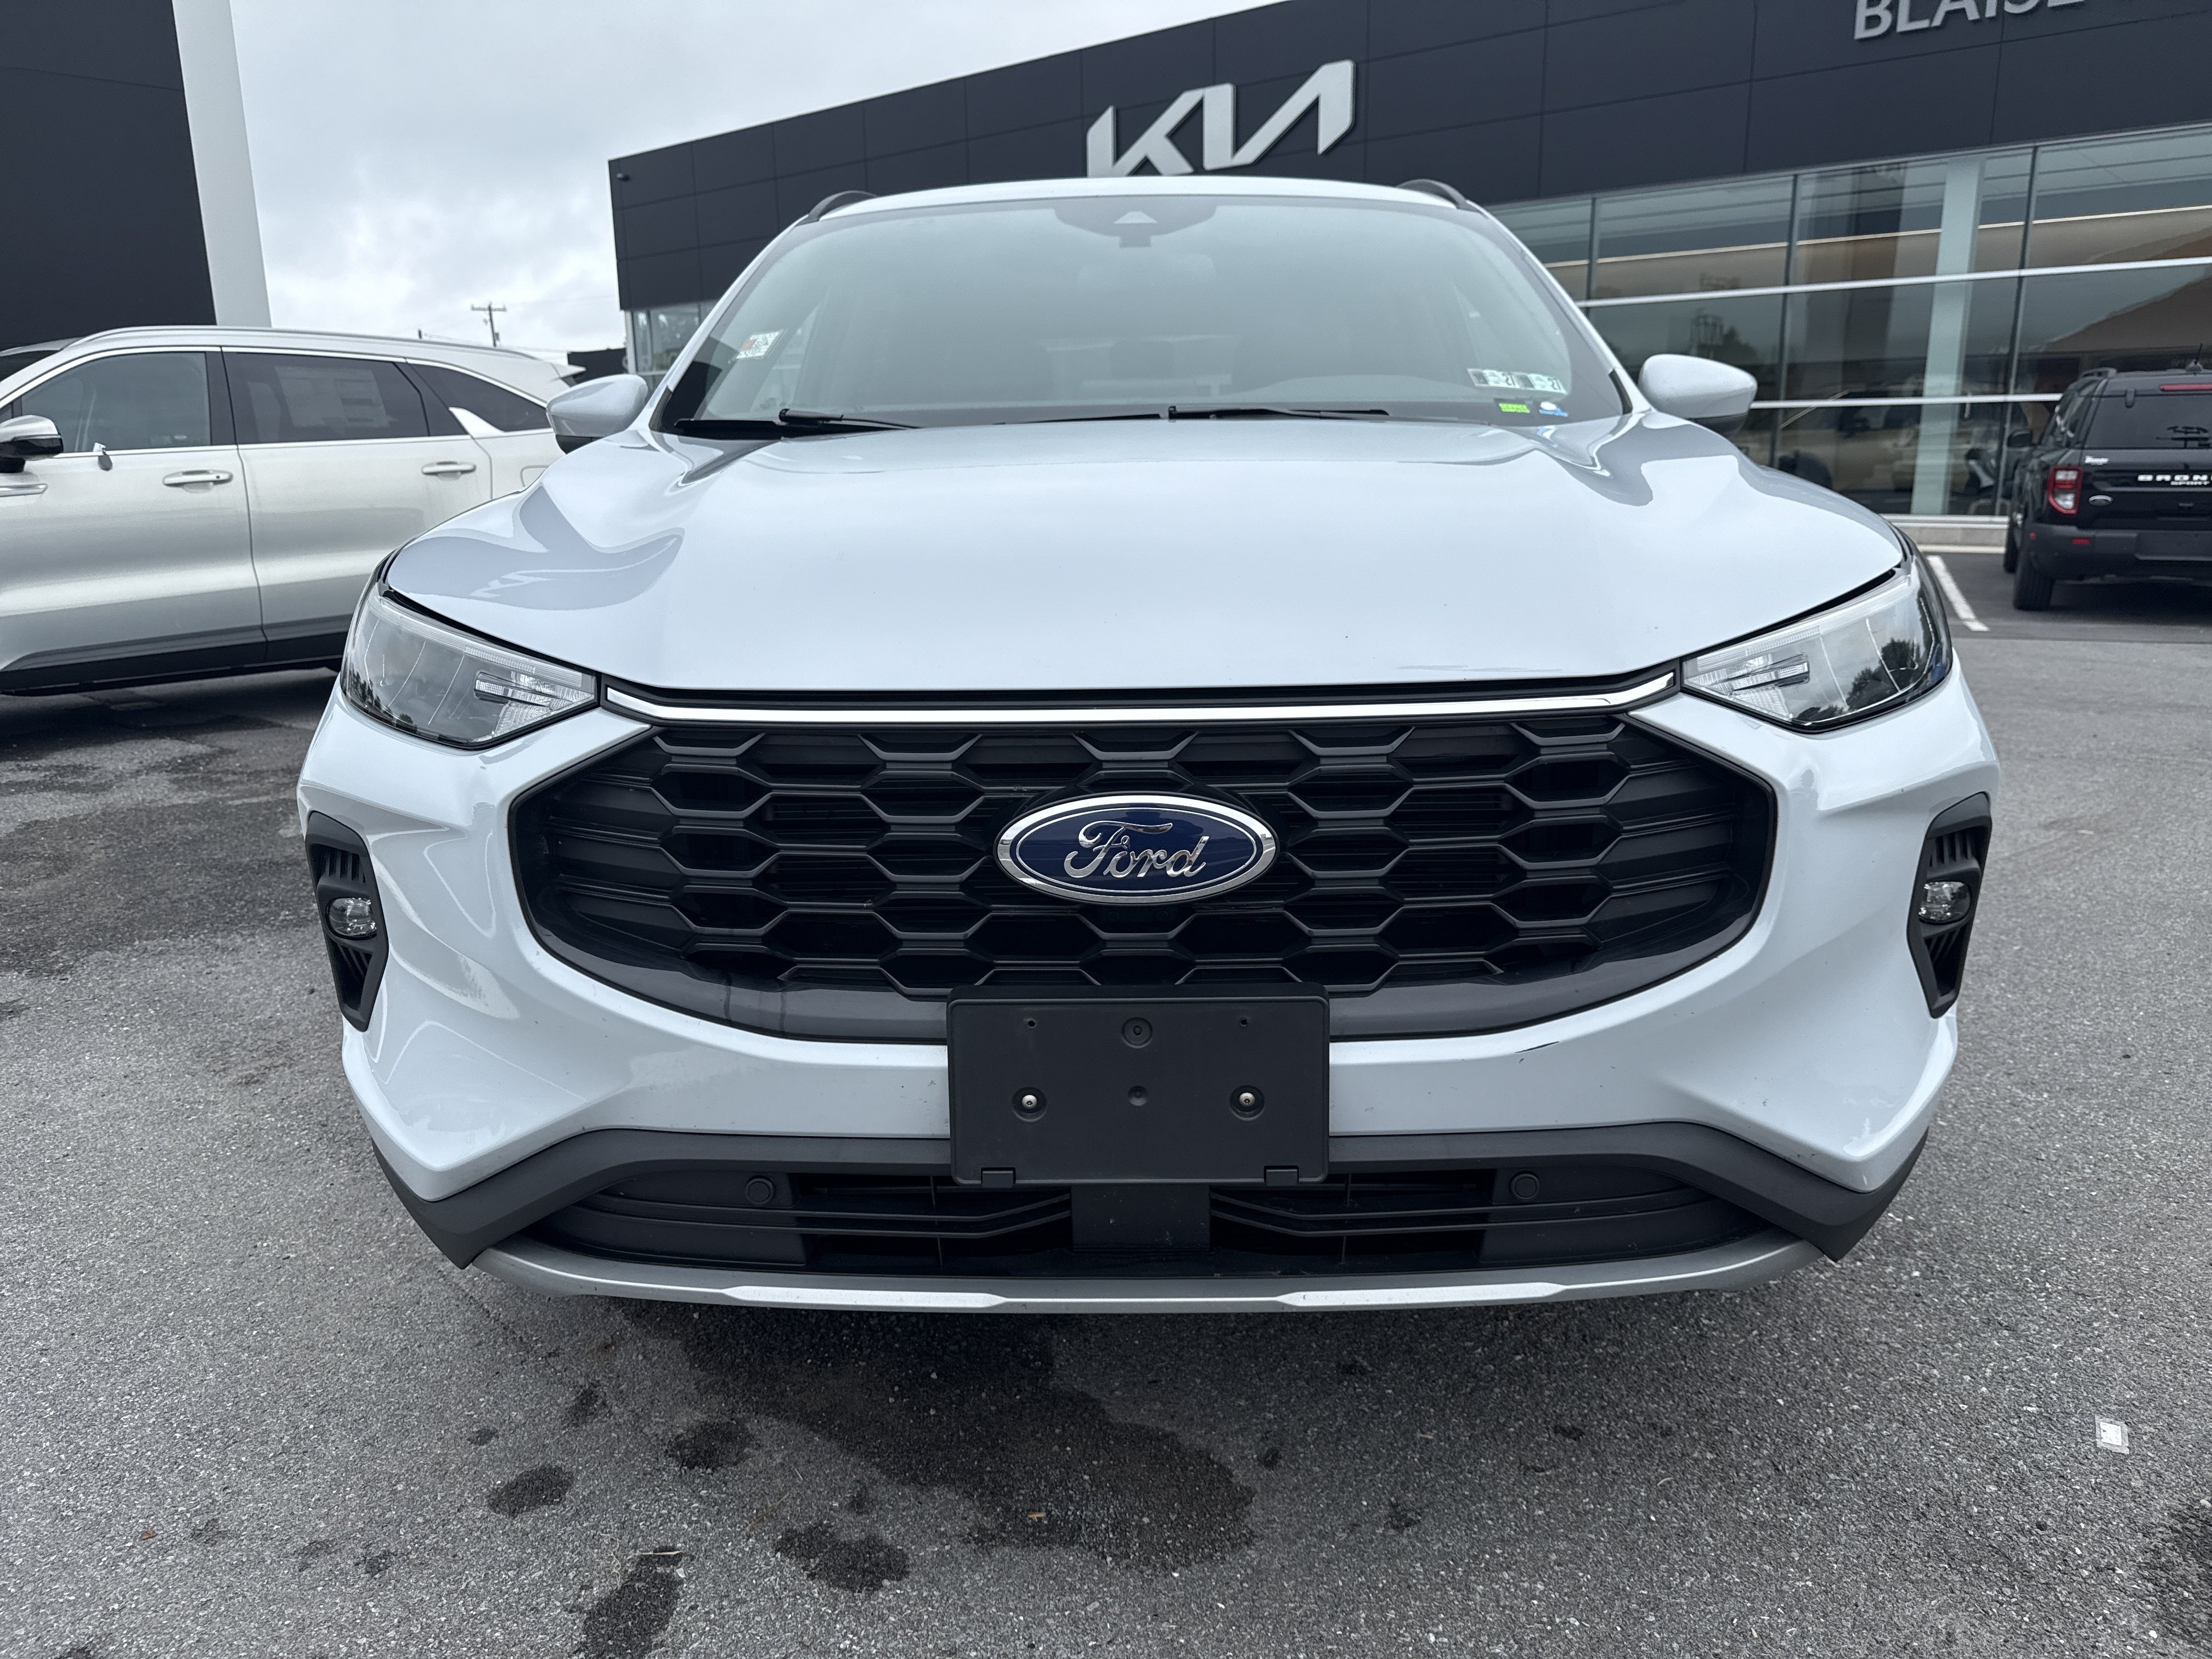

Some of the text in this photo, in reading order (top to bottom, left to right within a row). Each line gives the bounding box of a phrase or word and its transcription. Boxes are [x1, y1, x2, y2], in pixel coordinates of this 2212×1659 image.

[1854, 0, 2085, 40] BLA
[1086, 59, 1354, 177] KIA
[1064, 821, 1210, 878] Ford
